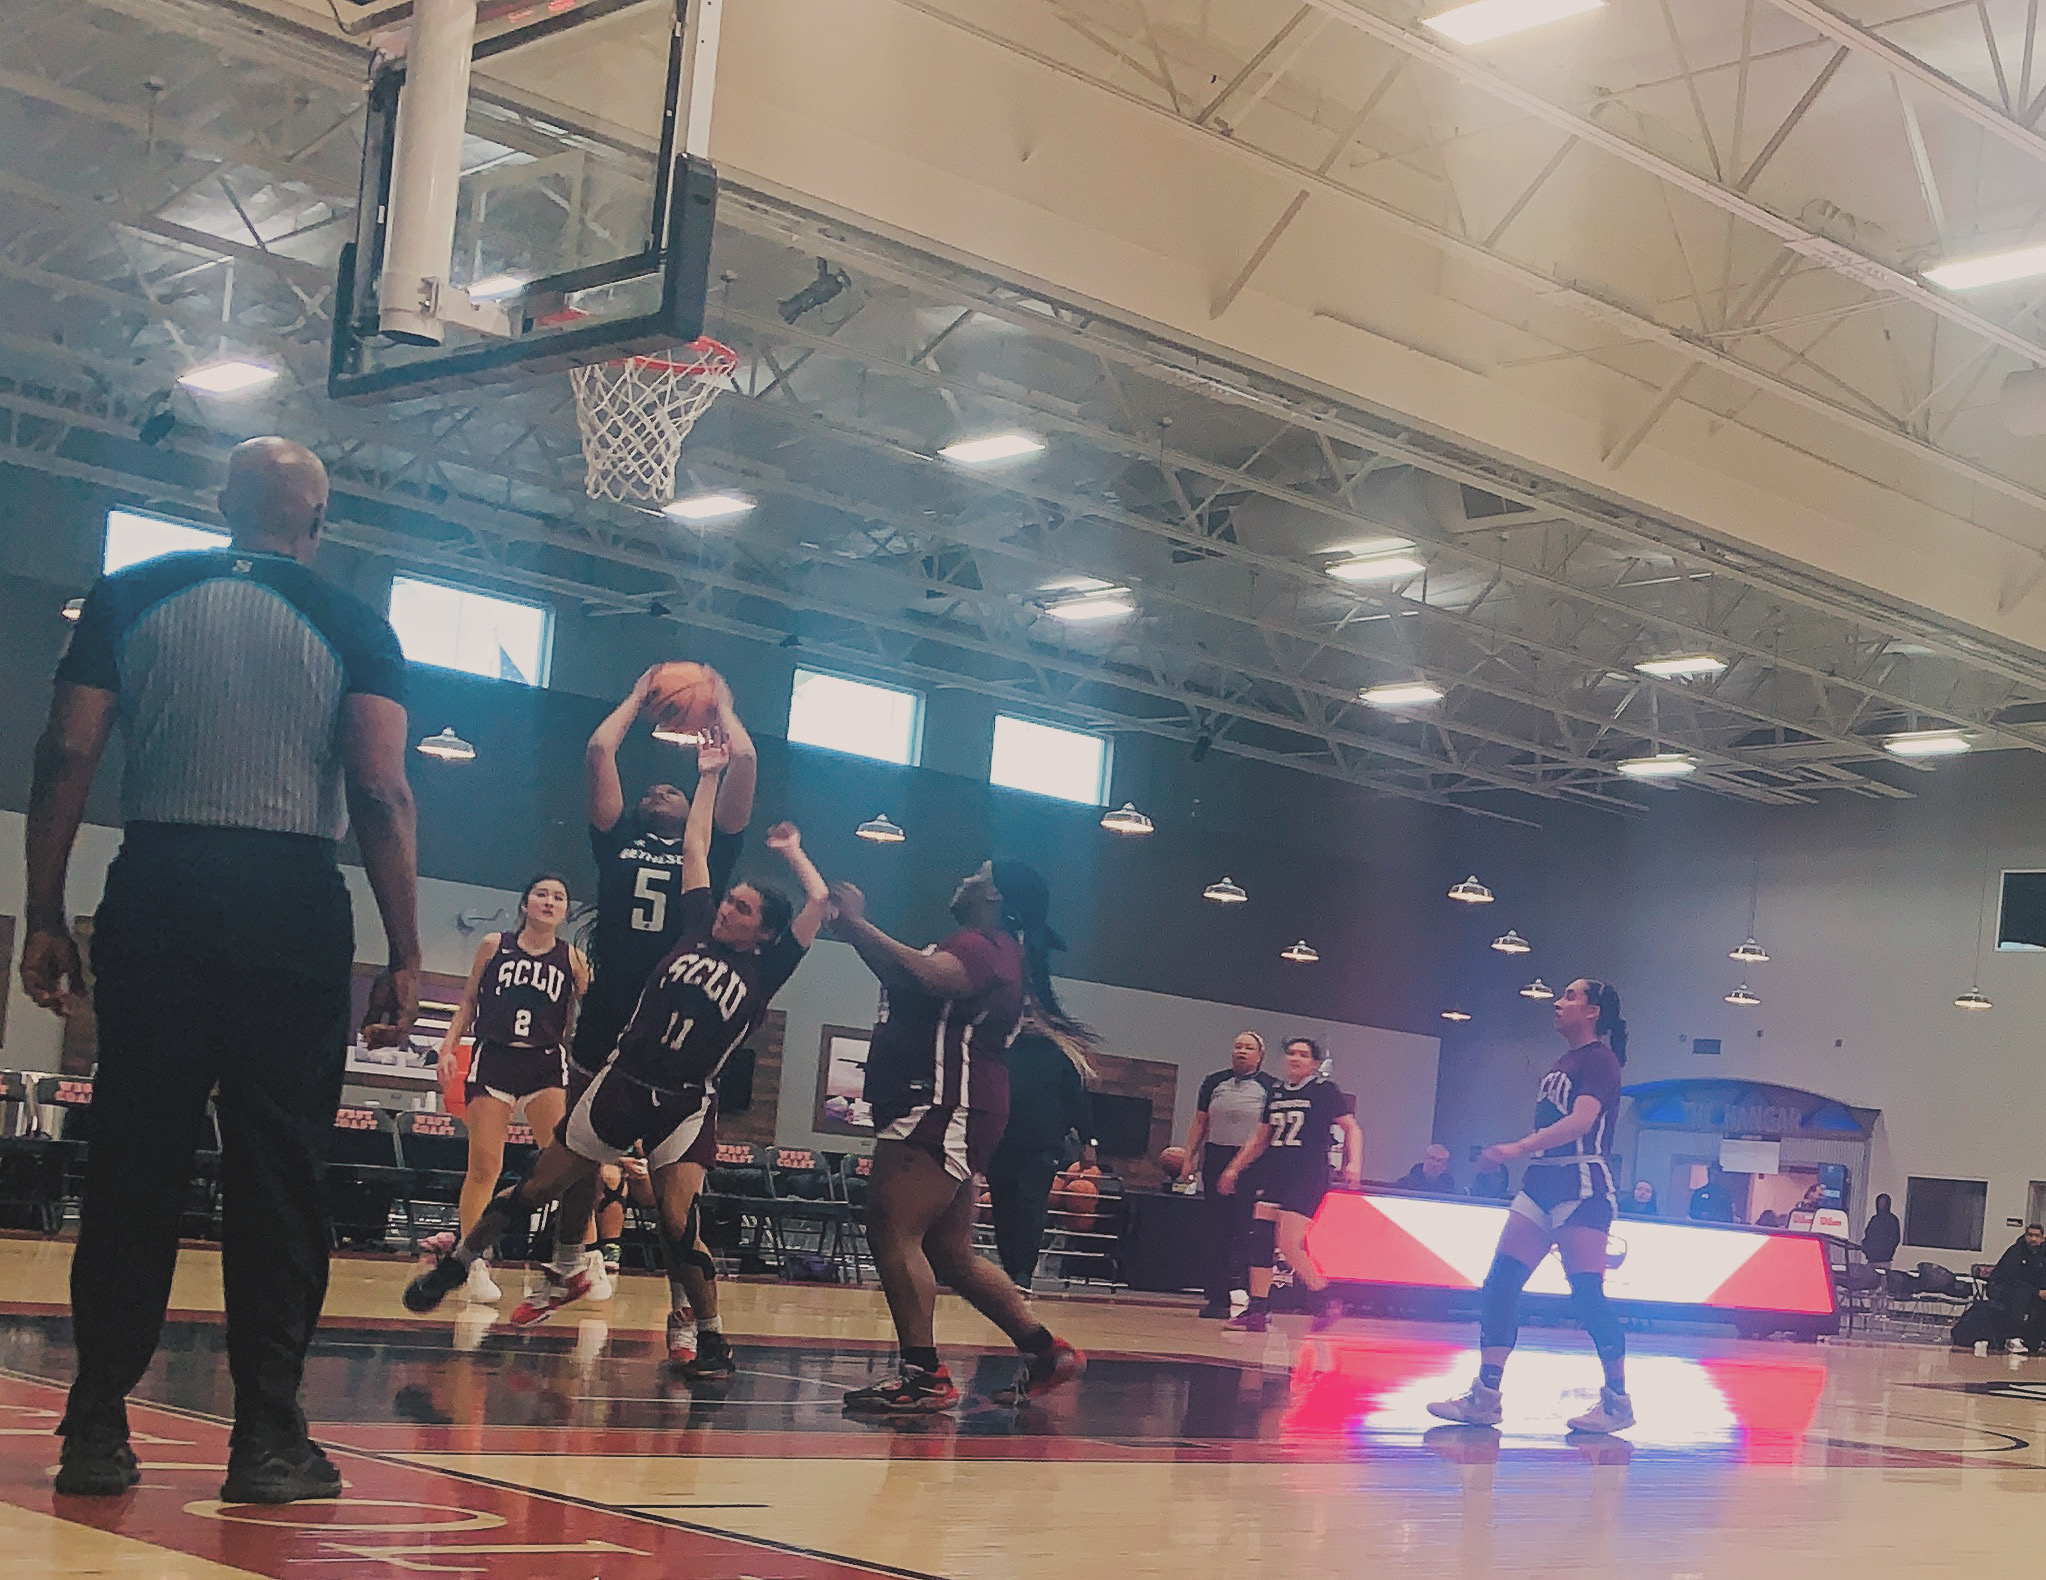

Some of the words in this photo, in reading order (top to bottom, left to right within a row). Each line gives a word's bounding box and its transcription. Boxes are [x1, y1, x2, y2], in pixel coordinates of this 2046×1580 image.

[631, 867, 671, 931] 5
[496, 959, 565, 1002] SCLU
[660, 953, 747, 1021] SCLU
[514, 1009, 531, 1037] 2
[661, 1011, 694, 1050] 11
[1269, 1110, 1305, 1147] 22
[715, 1152, 754, 1164] COAST
[716, 1144, 750, 1155] WEST
[776, 1157, 816, 1169] COAST
[778, 1150, 812, 1161] WEST
